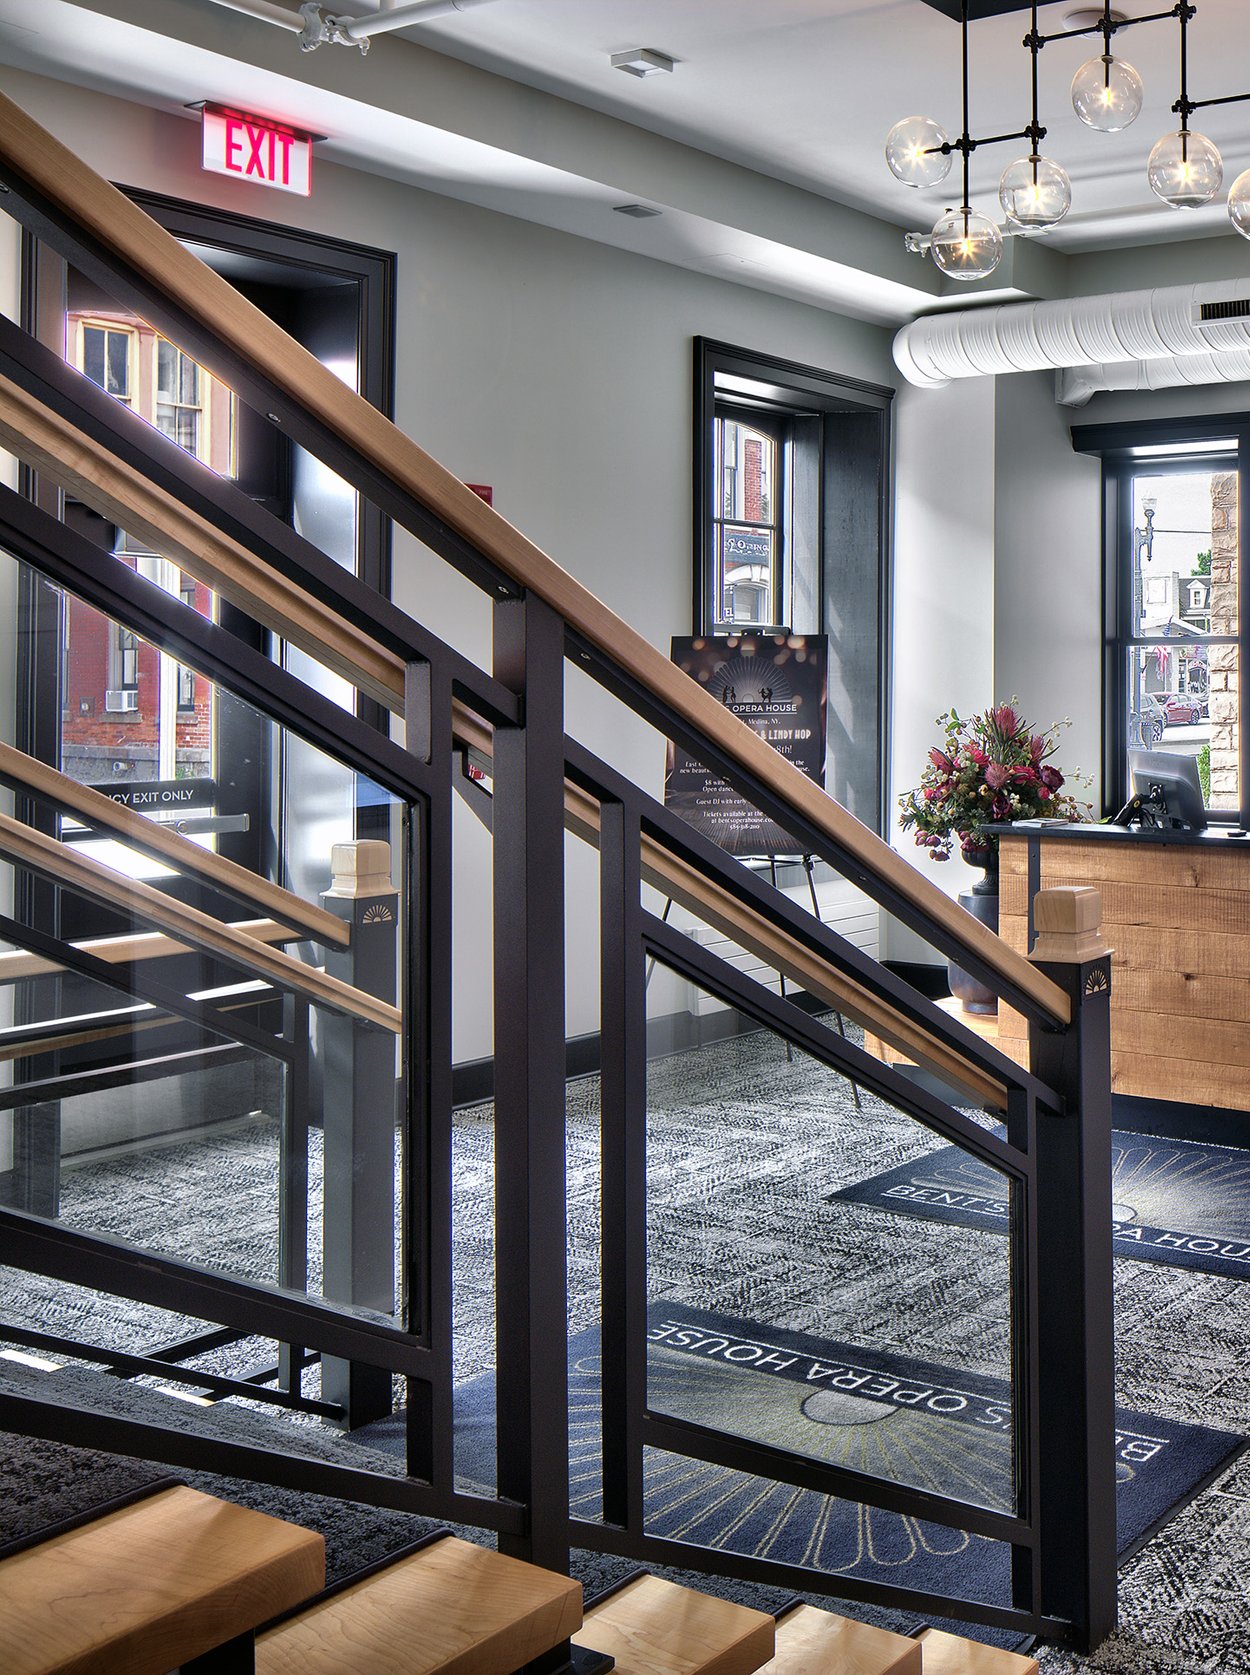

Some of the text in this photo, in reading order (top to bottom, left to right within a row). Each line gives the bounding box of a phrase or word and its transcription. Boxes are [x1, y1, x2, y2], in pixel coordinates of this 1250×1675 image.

[225, 118, 295, 186] EXIT
[732, 704, 764, 713] OPERA
[765, 703, 797, 712] HOUSE
[768, 729, 793, 740] LINDY
[794, 729, 811, 740] HOP
[132, 791, 159, 804] EXIT
[161, 790, 194, 802] ONLY
[886, 1184, 1010, 1213] BENT'S
[647, 1323, 799, 1373] HOUSE
[806, 1361, 968, 1412] OPERA
